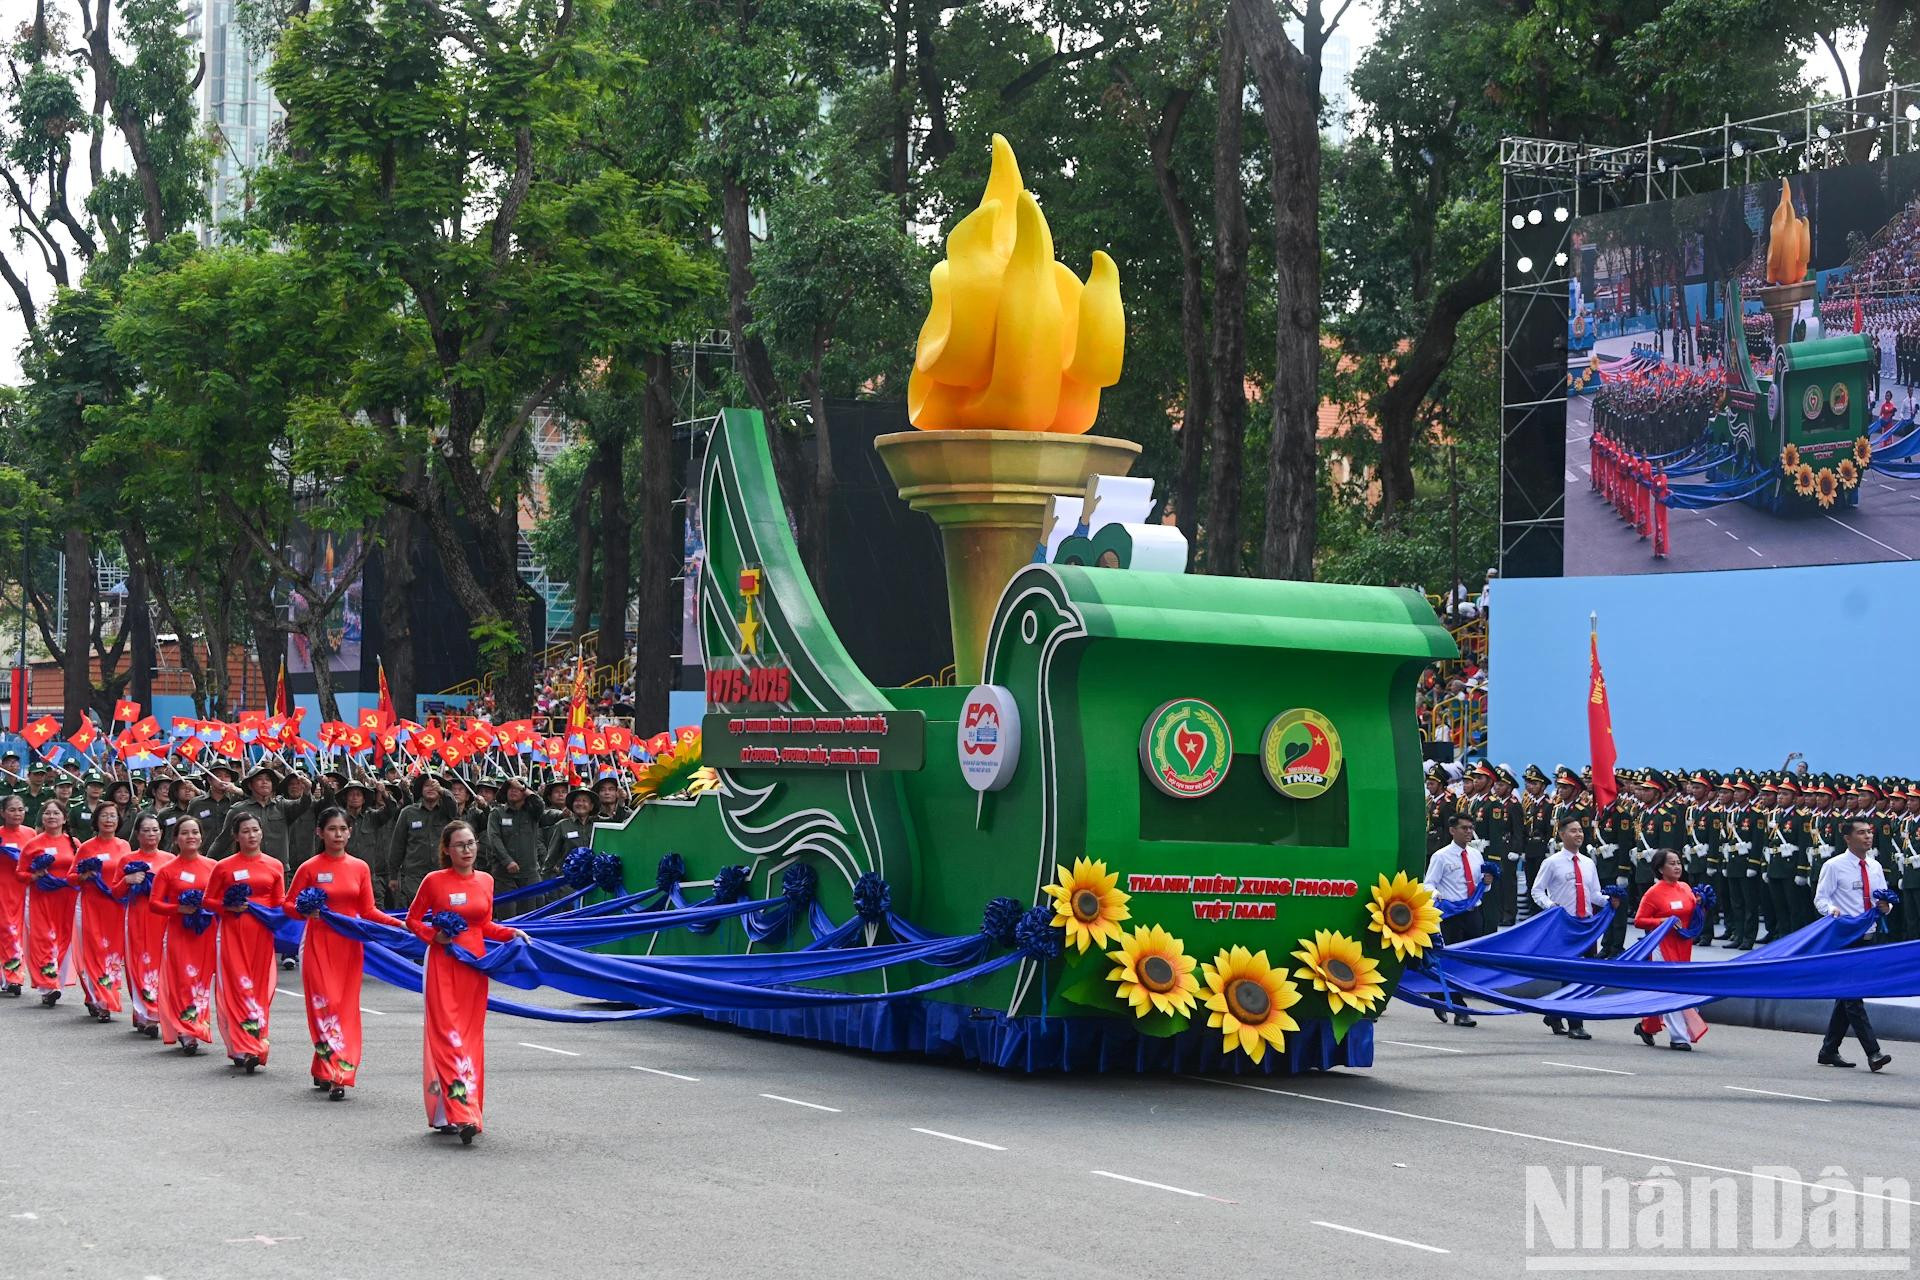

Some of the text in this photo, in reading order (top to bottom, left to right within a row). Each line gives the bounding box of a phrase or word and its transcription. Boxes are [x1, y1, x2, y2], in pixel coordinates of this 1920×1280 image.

[706, 667, 789, 702] 1975-2025
[1284, 774, 1323, 784] TNXP
[1128, 873, 1358, 897] THANH NIÊN XUNG PHONG
[1192, 899, 1277, 923] VIỆT NAM
